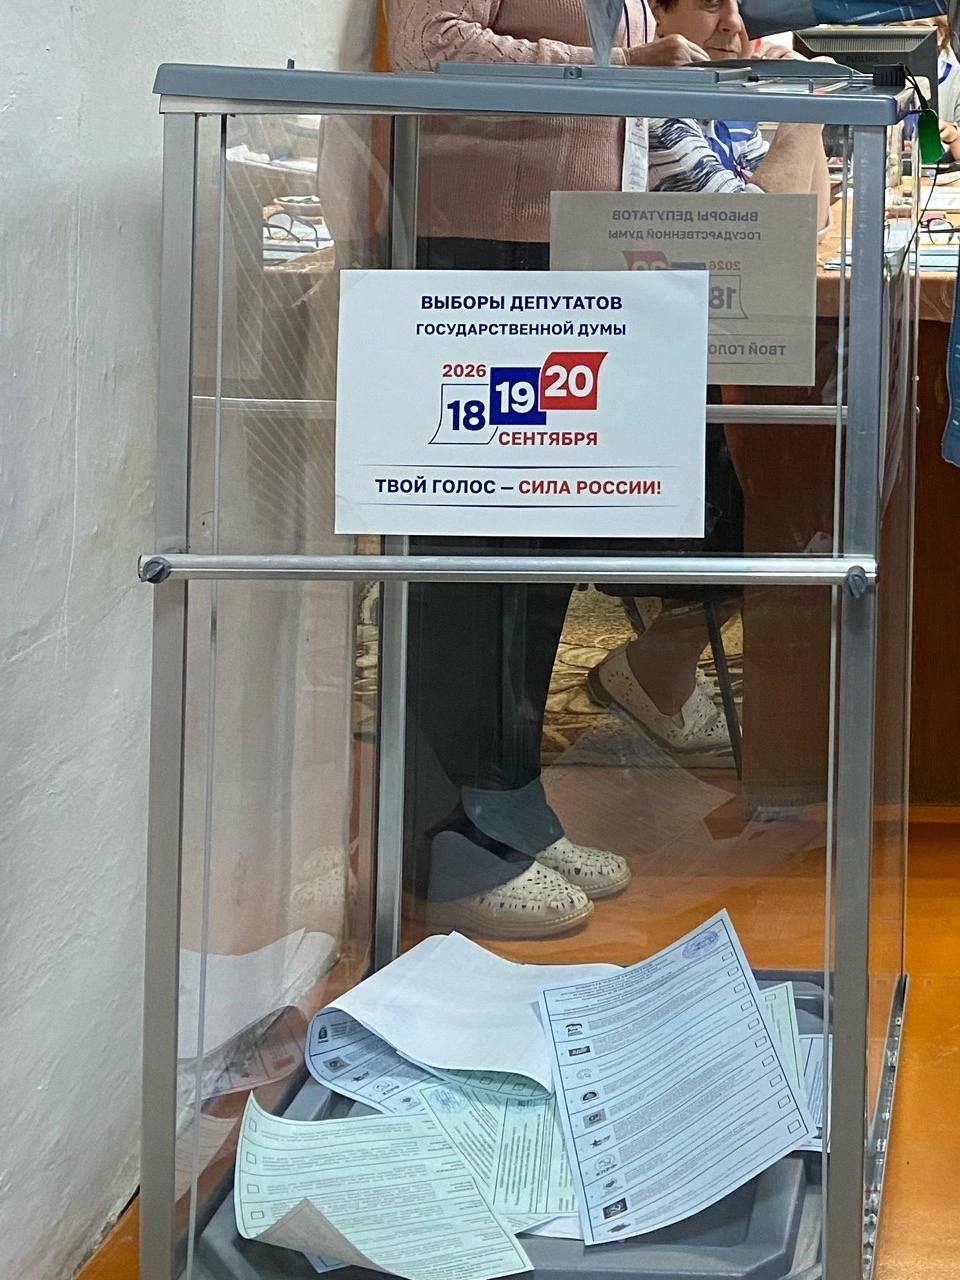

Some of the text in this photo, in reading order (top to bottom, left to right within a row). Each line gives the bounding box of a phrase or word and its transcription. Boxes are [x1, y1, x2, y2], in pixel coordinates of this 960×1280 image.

[421, 295, 623, 312] ВЫБОРЫ ДЕПУТАТОВ
[416, 320, 626, 337] ГОСУДАРСТВЕННОЙ ДУМЫ
[442, 364, 487, 378] 2026
[544, 364, 594, 398] 20
[495, 381, 536, 414] 19
[447, 400, 486, 431] 18
[498, 431, 598, 446] СЕНТЯБРЯ
[375, 475, 427, 494] ТВОЙ
[432, 479, 496, 494] ГОЛОС
[518, 480, 571, 495] СИЛА
[576, 480, 662, 495] РОССИИ!
